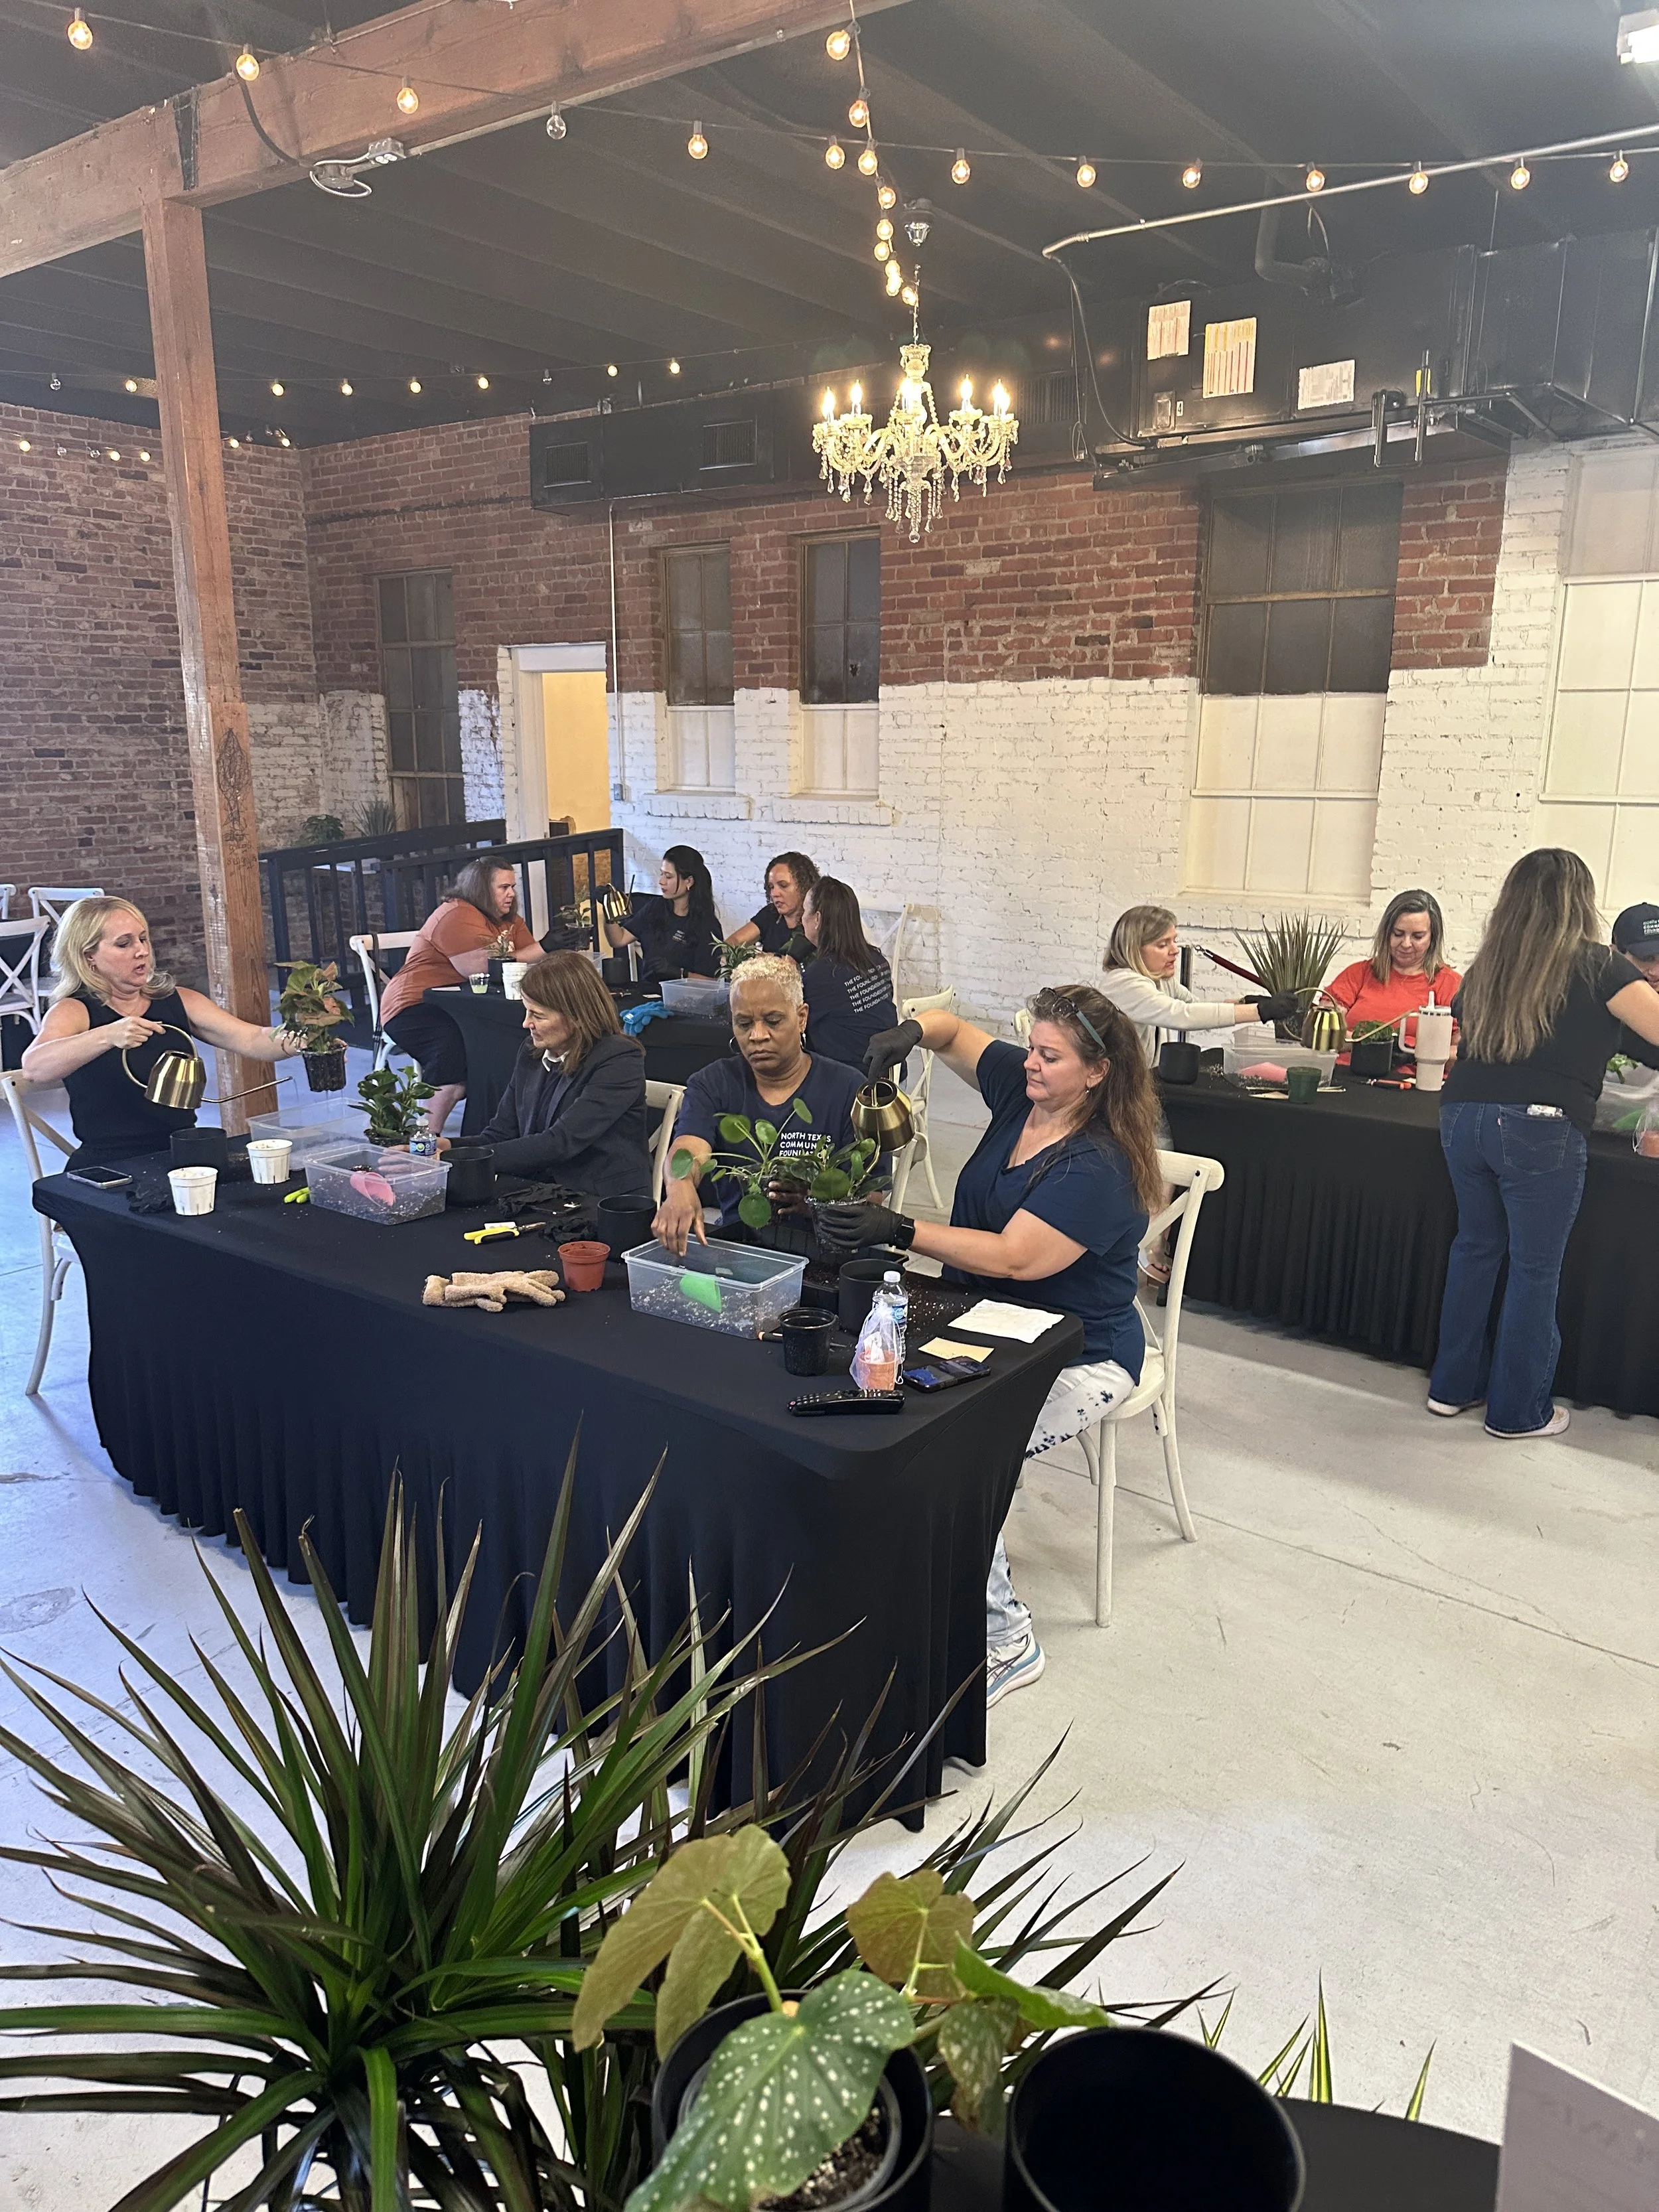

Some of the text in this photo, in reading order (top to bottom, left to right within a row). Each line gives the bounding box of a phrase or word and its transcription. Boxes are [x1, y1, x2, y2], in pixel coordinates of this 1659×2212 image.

[857, 975, 878, 989] FOUNO
[808, 1134, 831, 1142] TEXS
[779, 1149, 830, 1159] FOUNAO
